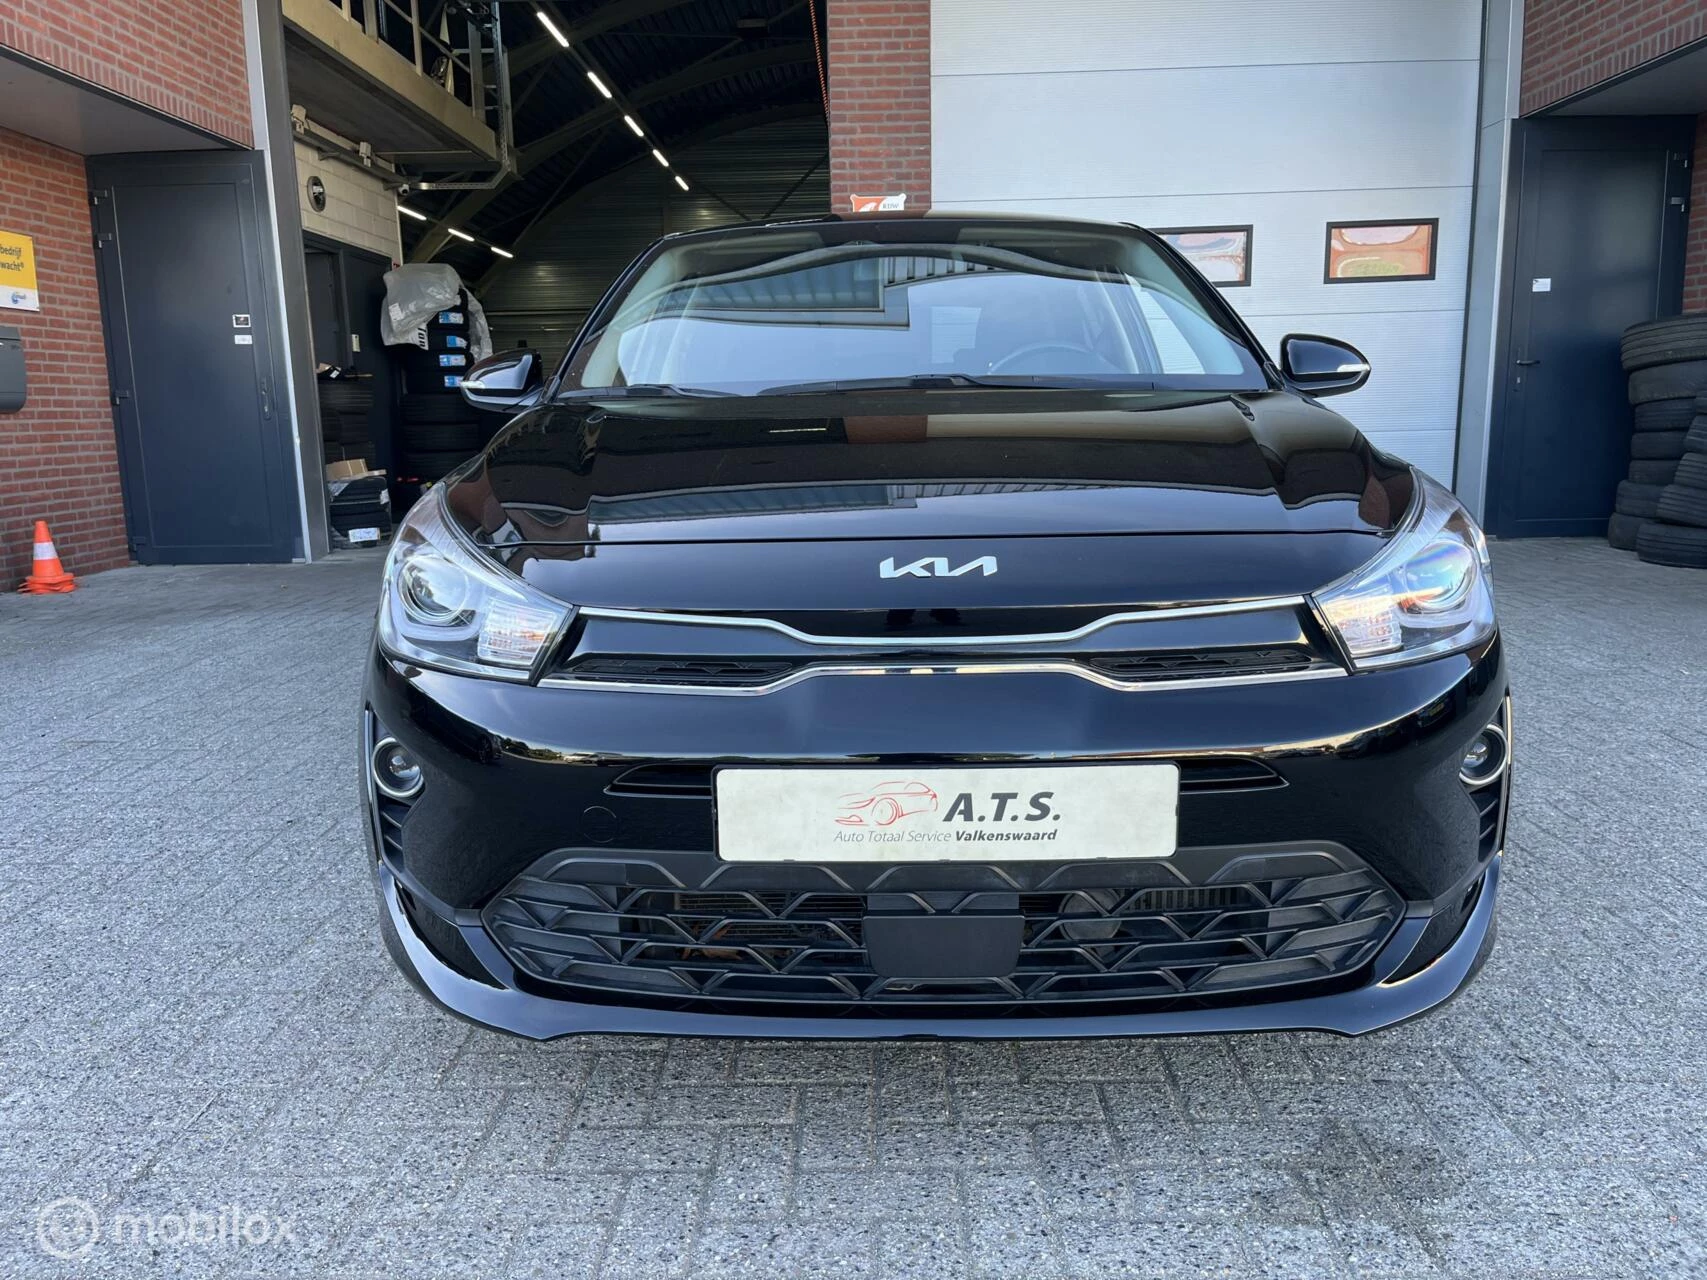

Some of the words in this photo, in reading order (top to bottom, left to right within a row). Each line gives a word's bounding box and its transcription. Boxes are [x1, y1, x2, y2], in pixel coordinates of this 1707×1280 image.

[880, 556, 998, 578] KIA
[942, 791, 1061, 822] A.T.S.
[833, 830, 865, 842] Auto
[868, 830, 905, 842] Totaal
[907, 830, 952, 842] Service
[955, 829, 1058, 842] Valkenswaard
